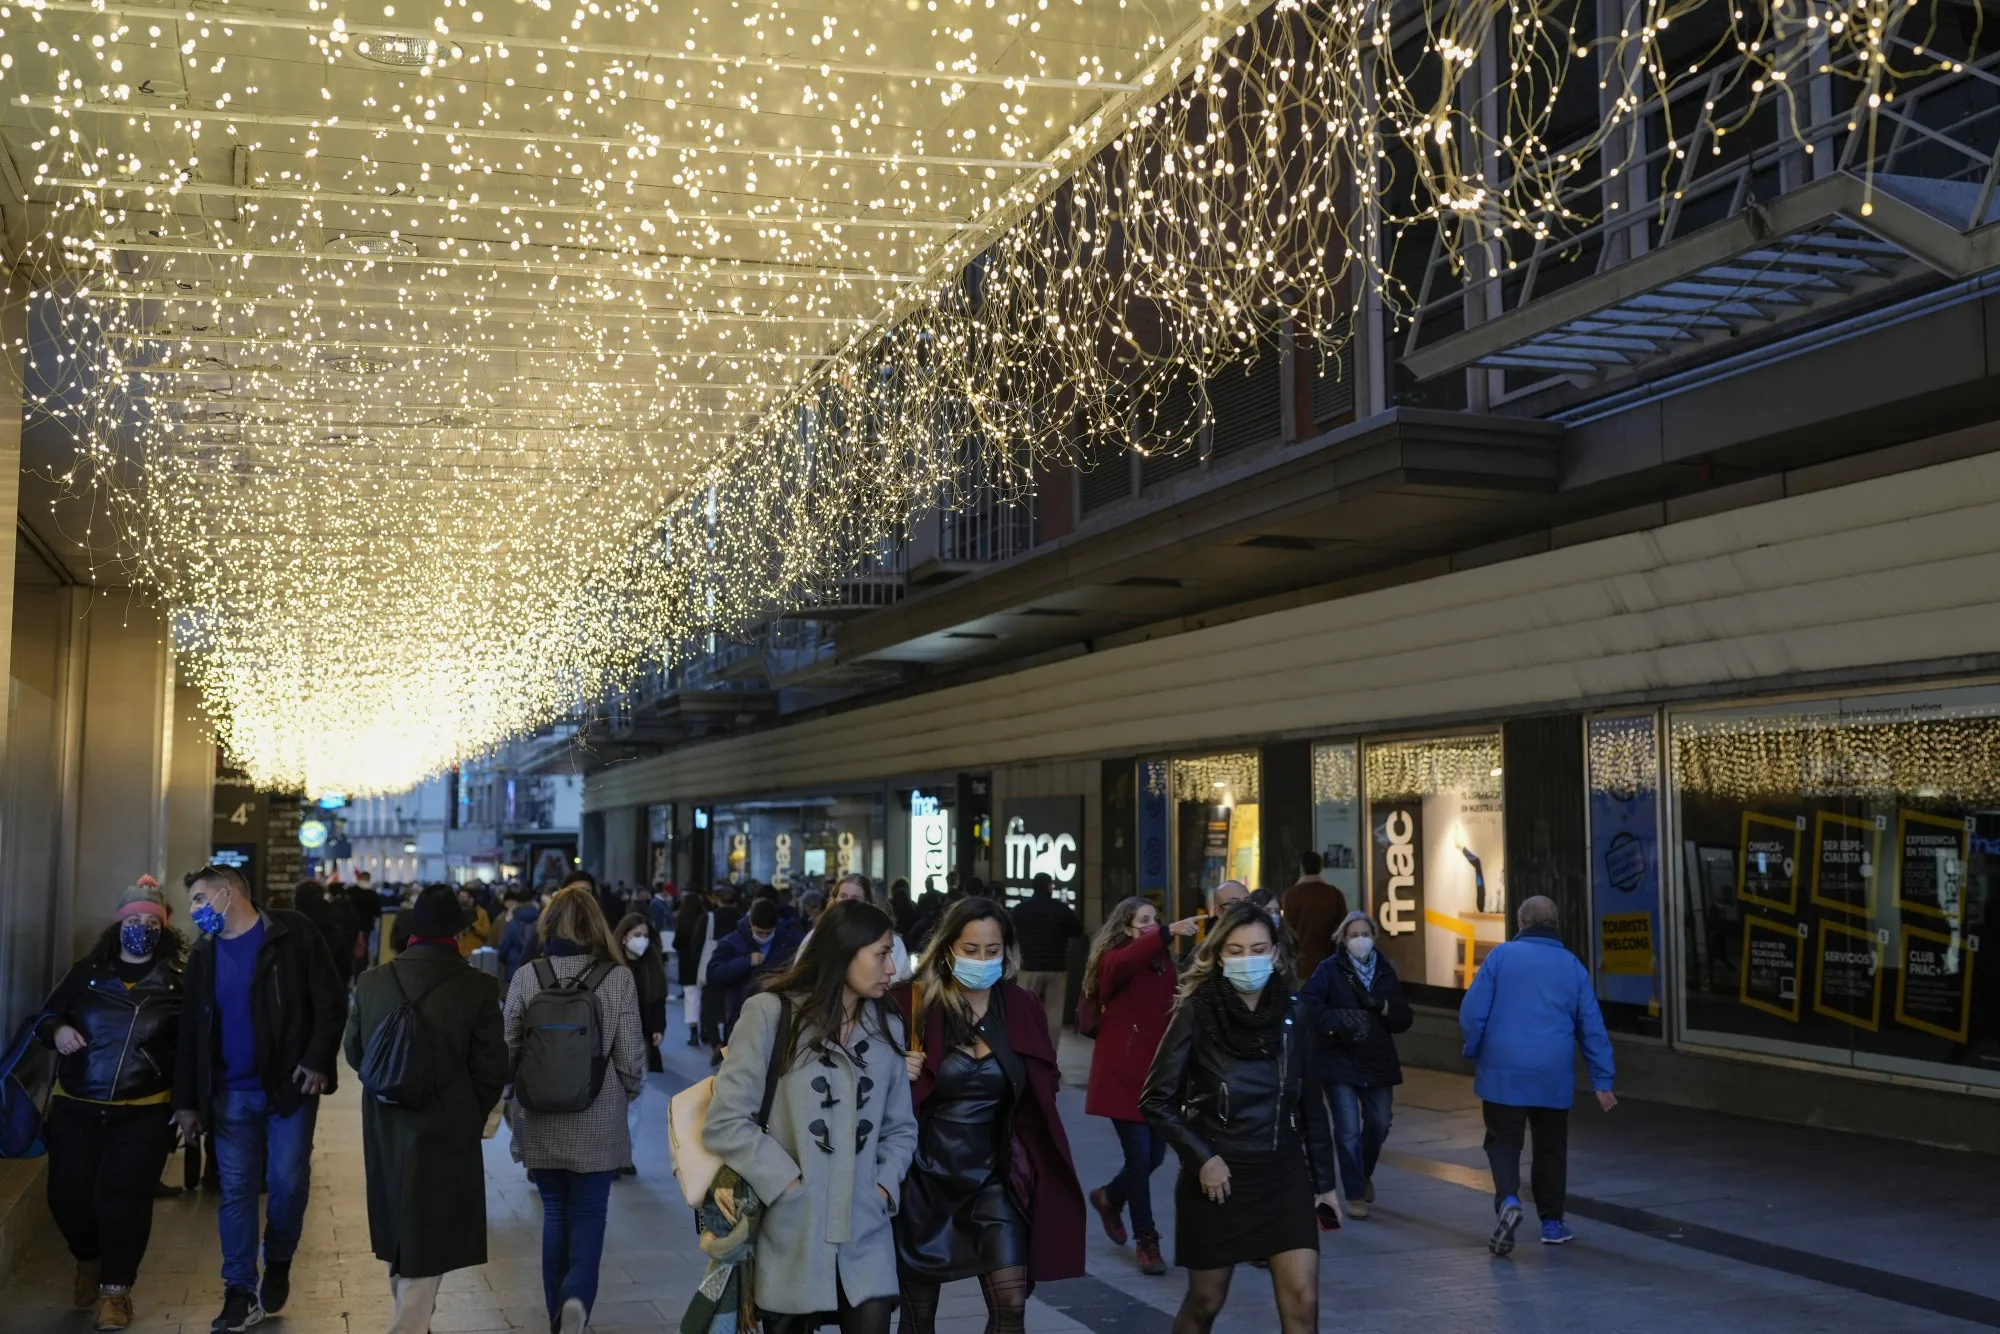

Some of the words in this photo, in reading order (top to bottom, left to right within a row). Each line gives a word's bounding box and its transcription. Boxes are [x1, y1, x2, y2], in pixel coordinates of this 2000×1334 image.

[911, 789, 939, 817] fnac
[1470, 803, 1493, 813] NUESTRA
[1823, 840, 1839, 850] SER
[1905, 835, 1957, 845] EXPERIENCIA
[1004, 815, 1077, 882] fnac
[1905, 847, 1917, 857] EN
[771, 833, 792, 891] fnac
[1823, 851, 1861, 863] CIALISTA
[1379, 810, 1416, 937] fnac
[1602, 918, 1649, 933] TOURISTS
[1603, 936, 1650, 951] WELCOME
[1824, 950, 1871, 965] SERVICIOS
[1909, 949, 1936, 963] CLUB
[1909, 963, 1942, 976] FNAC+
